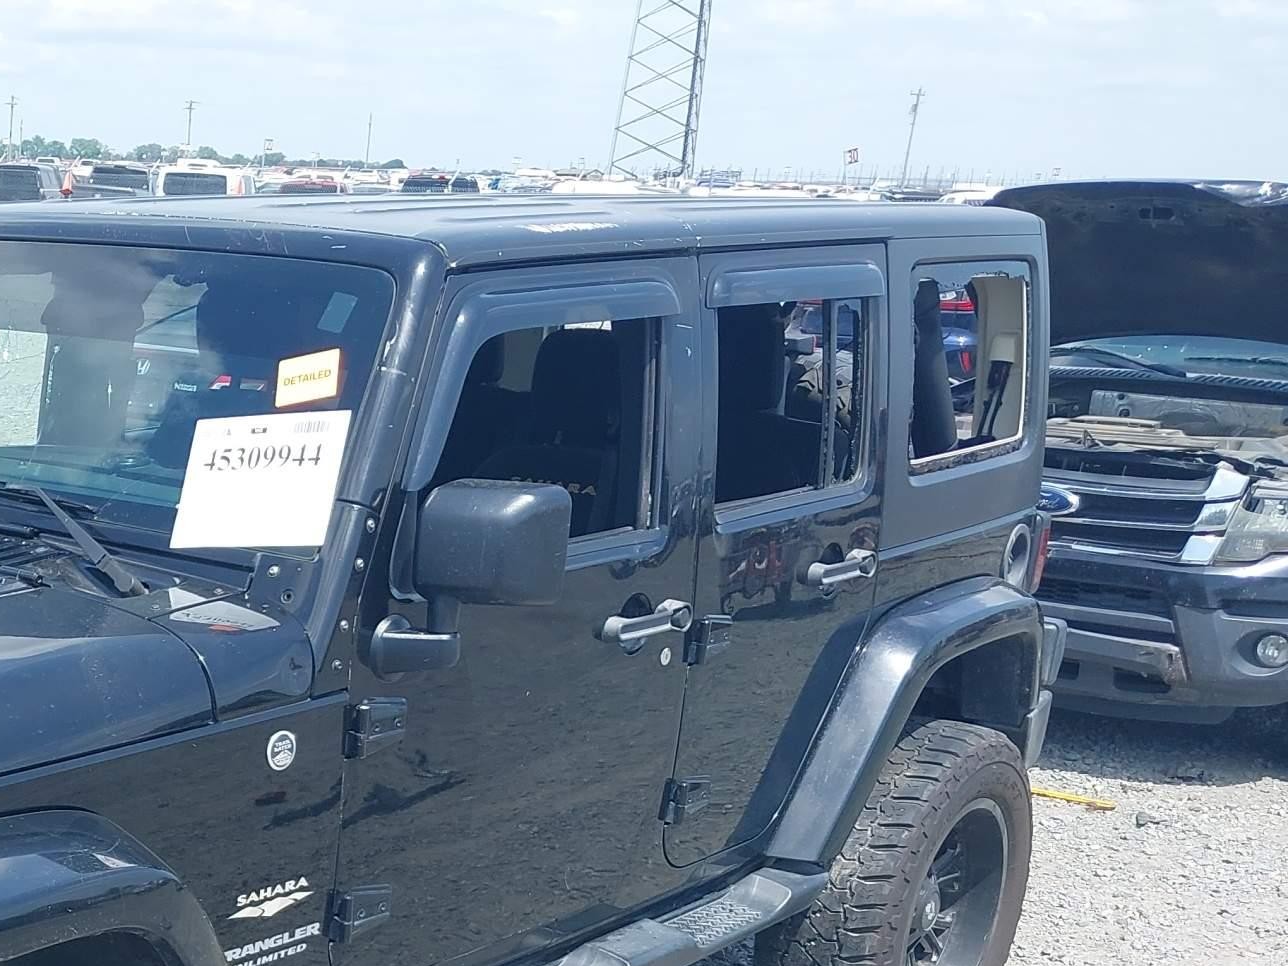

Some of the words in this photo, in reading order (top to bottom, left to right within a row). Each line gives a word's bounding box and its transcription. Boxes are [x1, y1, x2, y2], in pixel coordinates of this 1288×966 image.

[283, 368, 332, 387] DETAILED
[203, 443, 323, 472] 45309944
[236, 876, 309, 907] SAHARA
[223, 921, 321, 962] RANGLER
